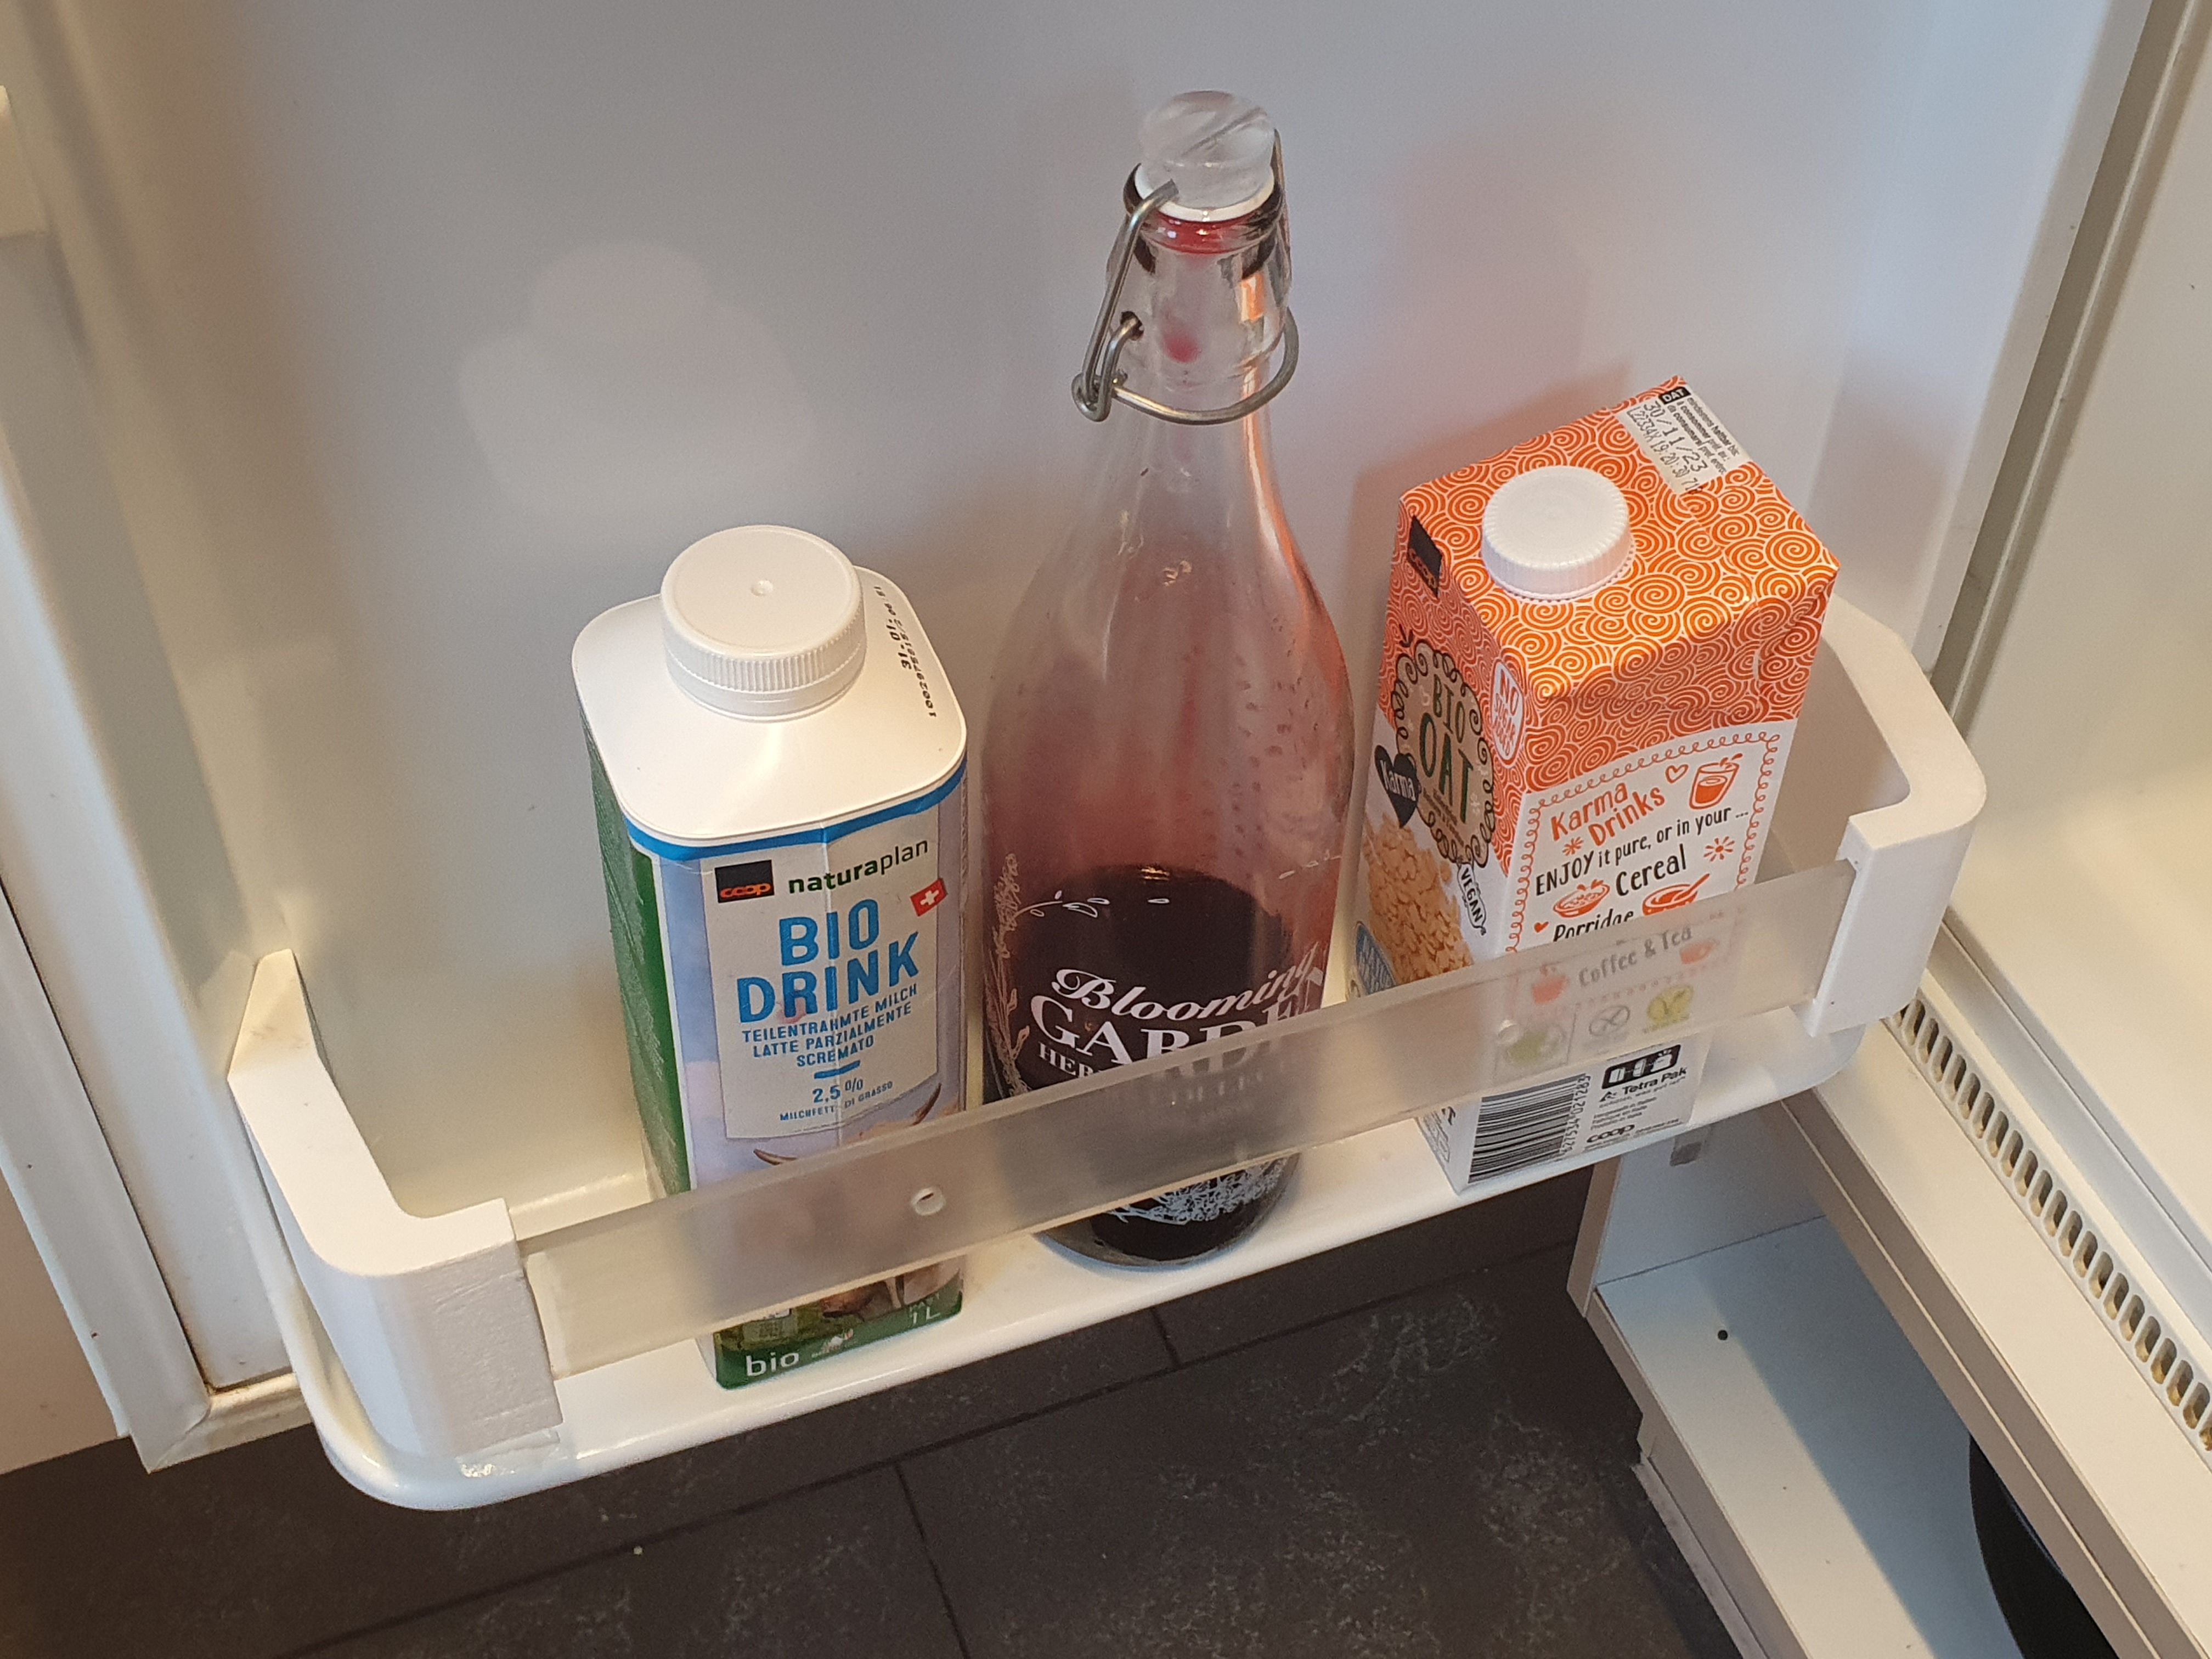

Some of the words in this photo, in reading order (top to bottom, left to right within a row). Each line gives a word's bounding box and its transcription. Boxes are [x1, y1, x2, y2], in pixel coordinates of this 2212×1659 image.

[1662, 389, 1685, 402] DAT
[1644, 401, 1708, 472] 30/11/23
[1433, 674, 1465, 744] BIO
[1500, 669, 1519, 716] NO
[1380, 759, 1416, 802] Karma
[1419, 713, 1474, 823] OAT
[1550, 783, 1629, 841] Karma
[1588, 787, 1666, 846] Drinks
[720, 883, 771, 899] coop
[789, 840, 928, 894] naturaplan
[1536, 850, 1594, 896] ENJOY
[1598, 850, 1610, 867] it
[1615, 836, 1651, 866] pure,
[1656, 825, 1672, 843] or
[1677, 819, 1690, 837] in
[1696, 807, 1732, 836] your
[1616, 843, 1687, 896] Cereal
[1460, 867, 1483, 923] VEGAN
[779, 898, 880, 966] BIO
[737, 931, 919, 1024] DRINK
[1052, 942, 1318, 1021] Blooming
[742, 1006, 870, 1043] TEILENTRAHMTE
[875, 984, 917, 1013] MILCH
[753, 1040, 799, 1058] LATTE
[806, 1002, 911, 1051] PARZIALMENTE
[797, 1035, 874, 1067] SCREMATO
[780, 1105, 836, 1121] MILCHFETT
[845, 1098, 855, 1108] DI
[858, 1081, 893, 1102] GRASSO
[1622, 1079, 1658, 1095] Tetra
[1661, 1067, 1688, 1083] Pak
[1587, 1124, 1635, 1143] coop
[746, 1351, 800, 1378] bio
